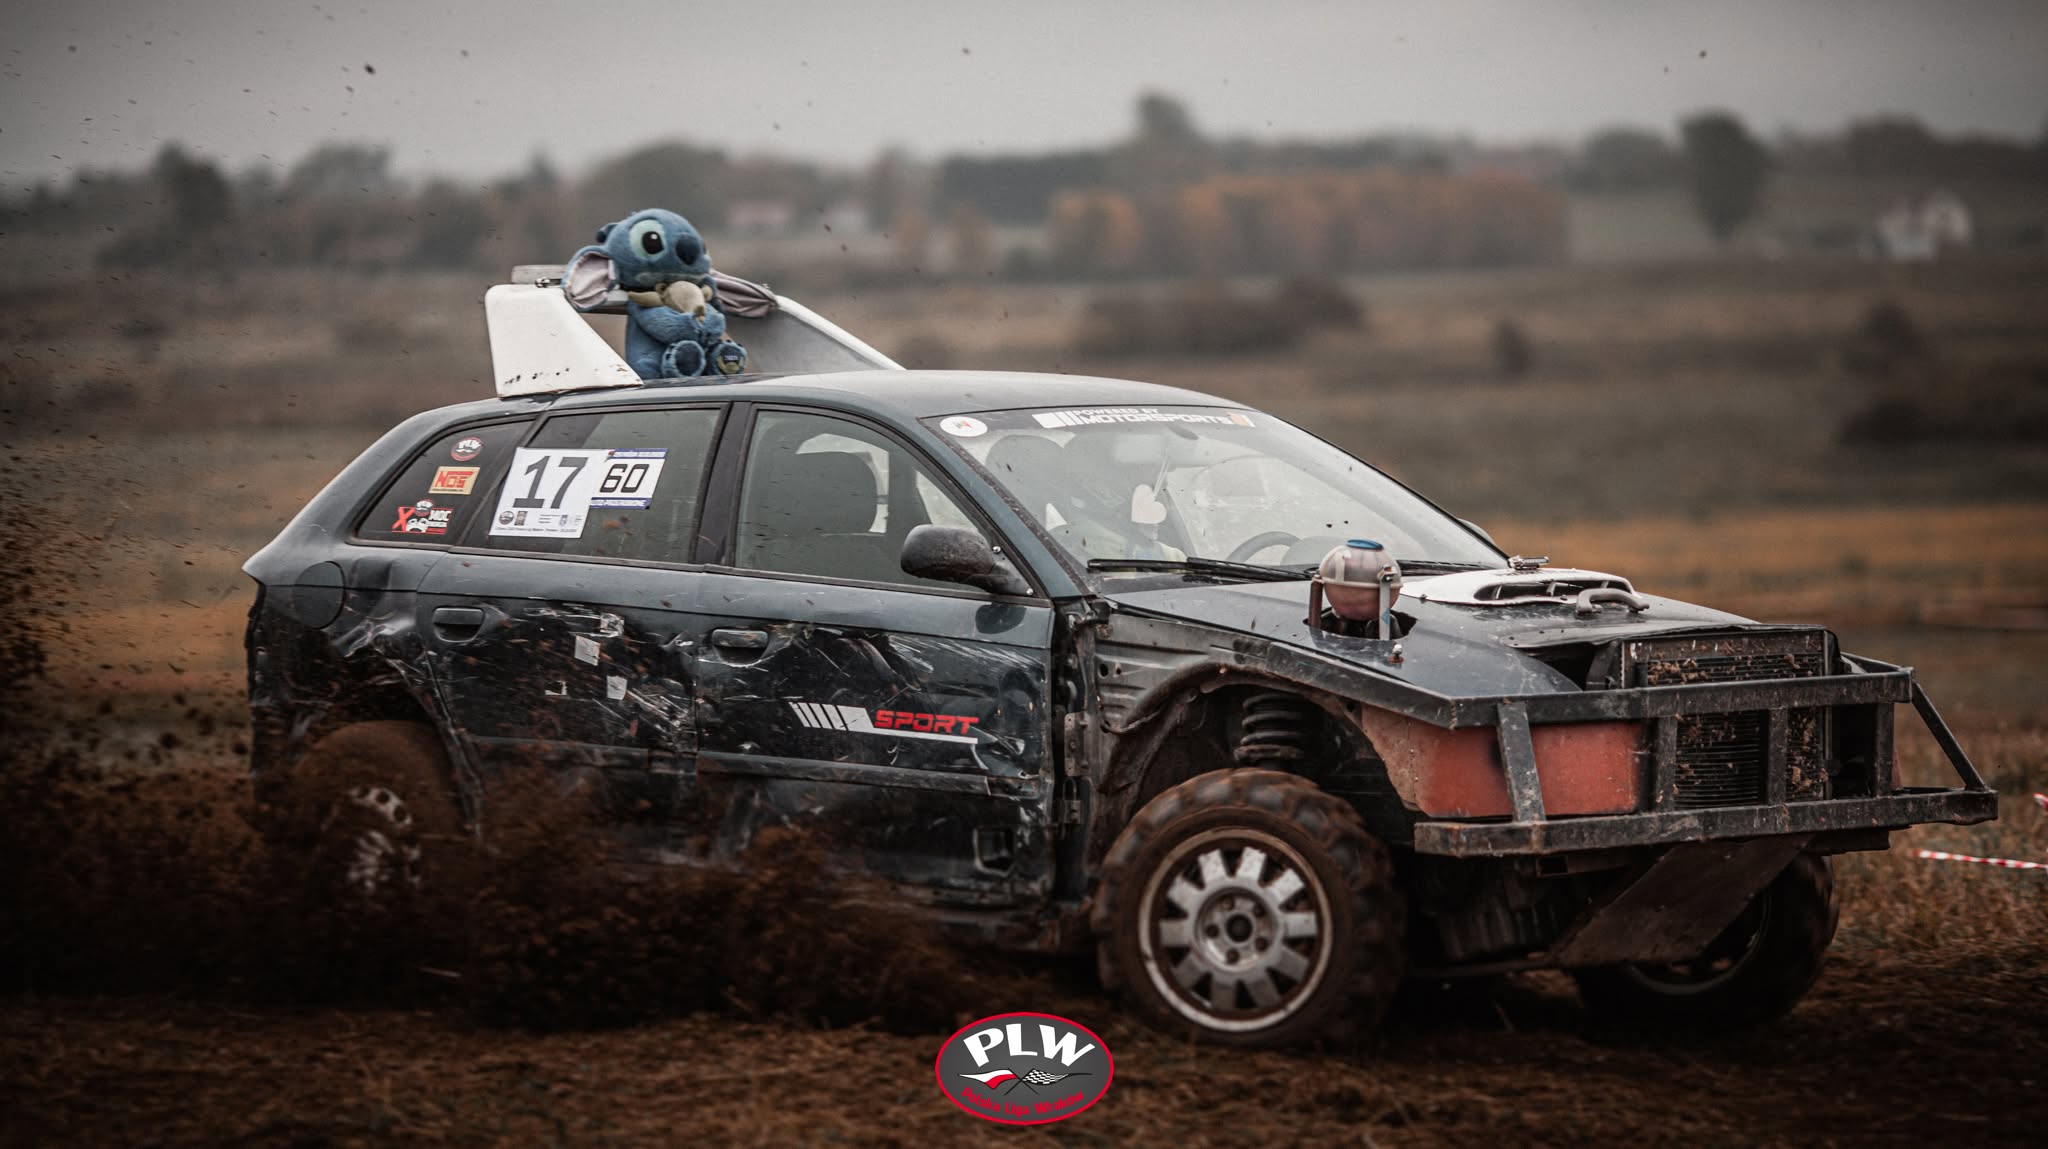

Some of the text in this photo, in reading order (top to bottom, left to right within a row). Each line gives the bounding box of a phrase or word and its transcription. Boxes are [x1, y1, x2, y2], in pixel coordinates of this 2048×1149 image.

[1079, 413, 1234, 425] MOTORSPORTS
[435, 471, 475, 489] NOS
[513, 455, 589, 509] 17
[599, 463, 650, 493] 60
[873, 709, 980, 735] SPORT
